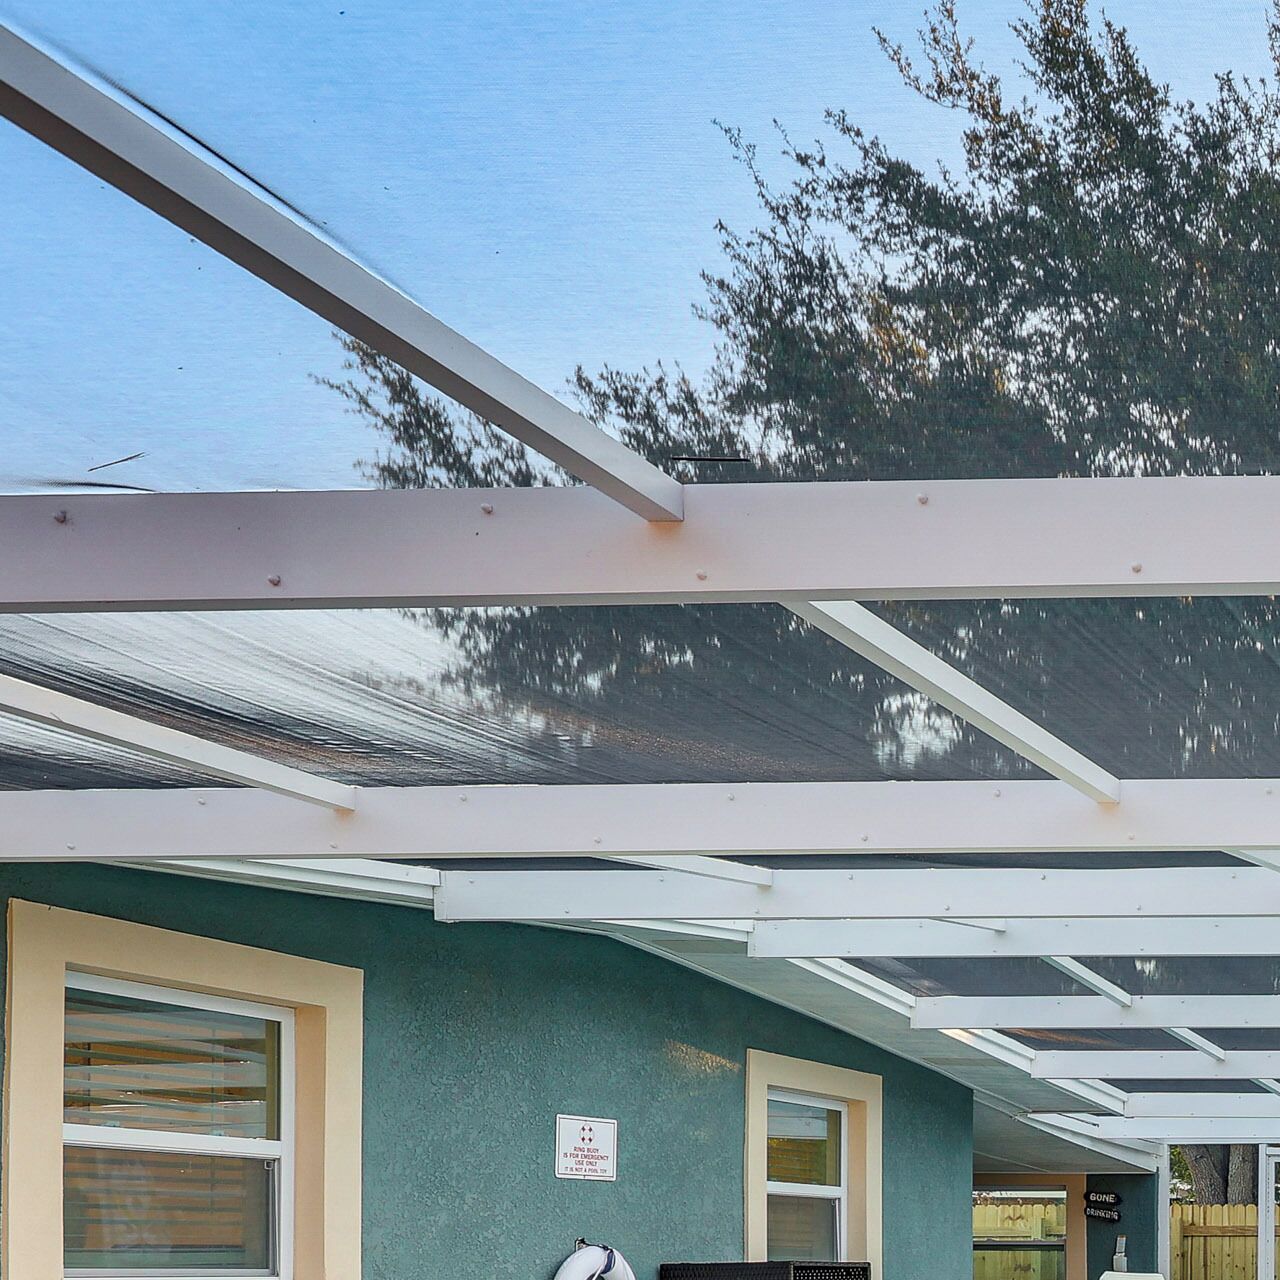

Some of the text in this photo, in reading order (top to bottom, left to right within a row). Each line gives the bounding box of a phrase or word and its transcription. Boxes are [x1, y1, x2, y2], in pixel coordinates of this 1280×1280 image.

[580, 1153, 609, 1161] EMERGENCY
[1090, 1192, 1116, 1203] GONE
[1086, 1207, 1119, 1220] DRINKING
